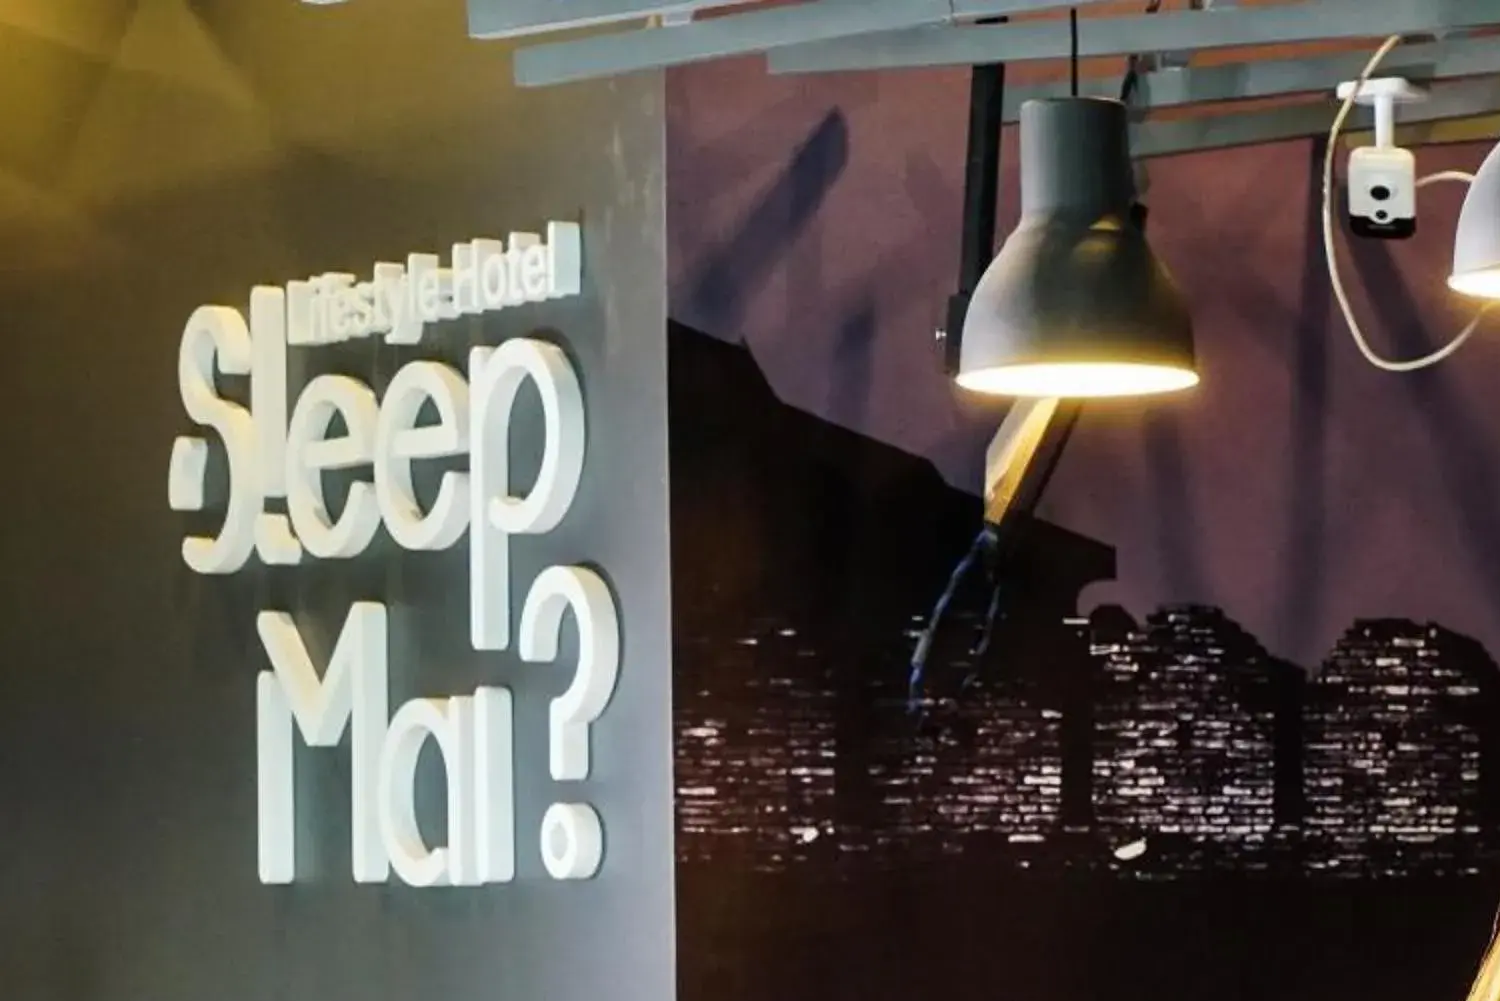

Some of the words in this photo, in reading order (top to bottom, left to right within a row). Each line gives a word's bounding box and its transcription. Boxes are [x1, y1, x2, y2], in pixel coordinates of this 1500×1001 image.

[452, 219, 581, 314] Hotel
[168, 285, 586, 651] Sleep
[256, 564, 620, 888] Mai?
